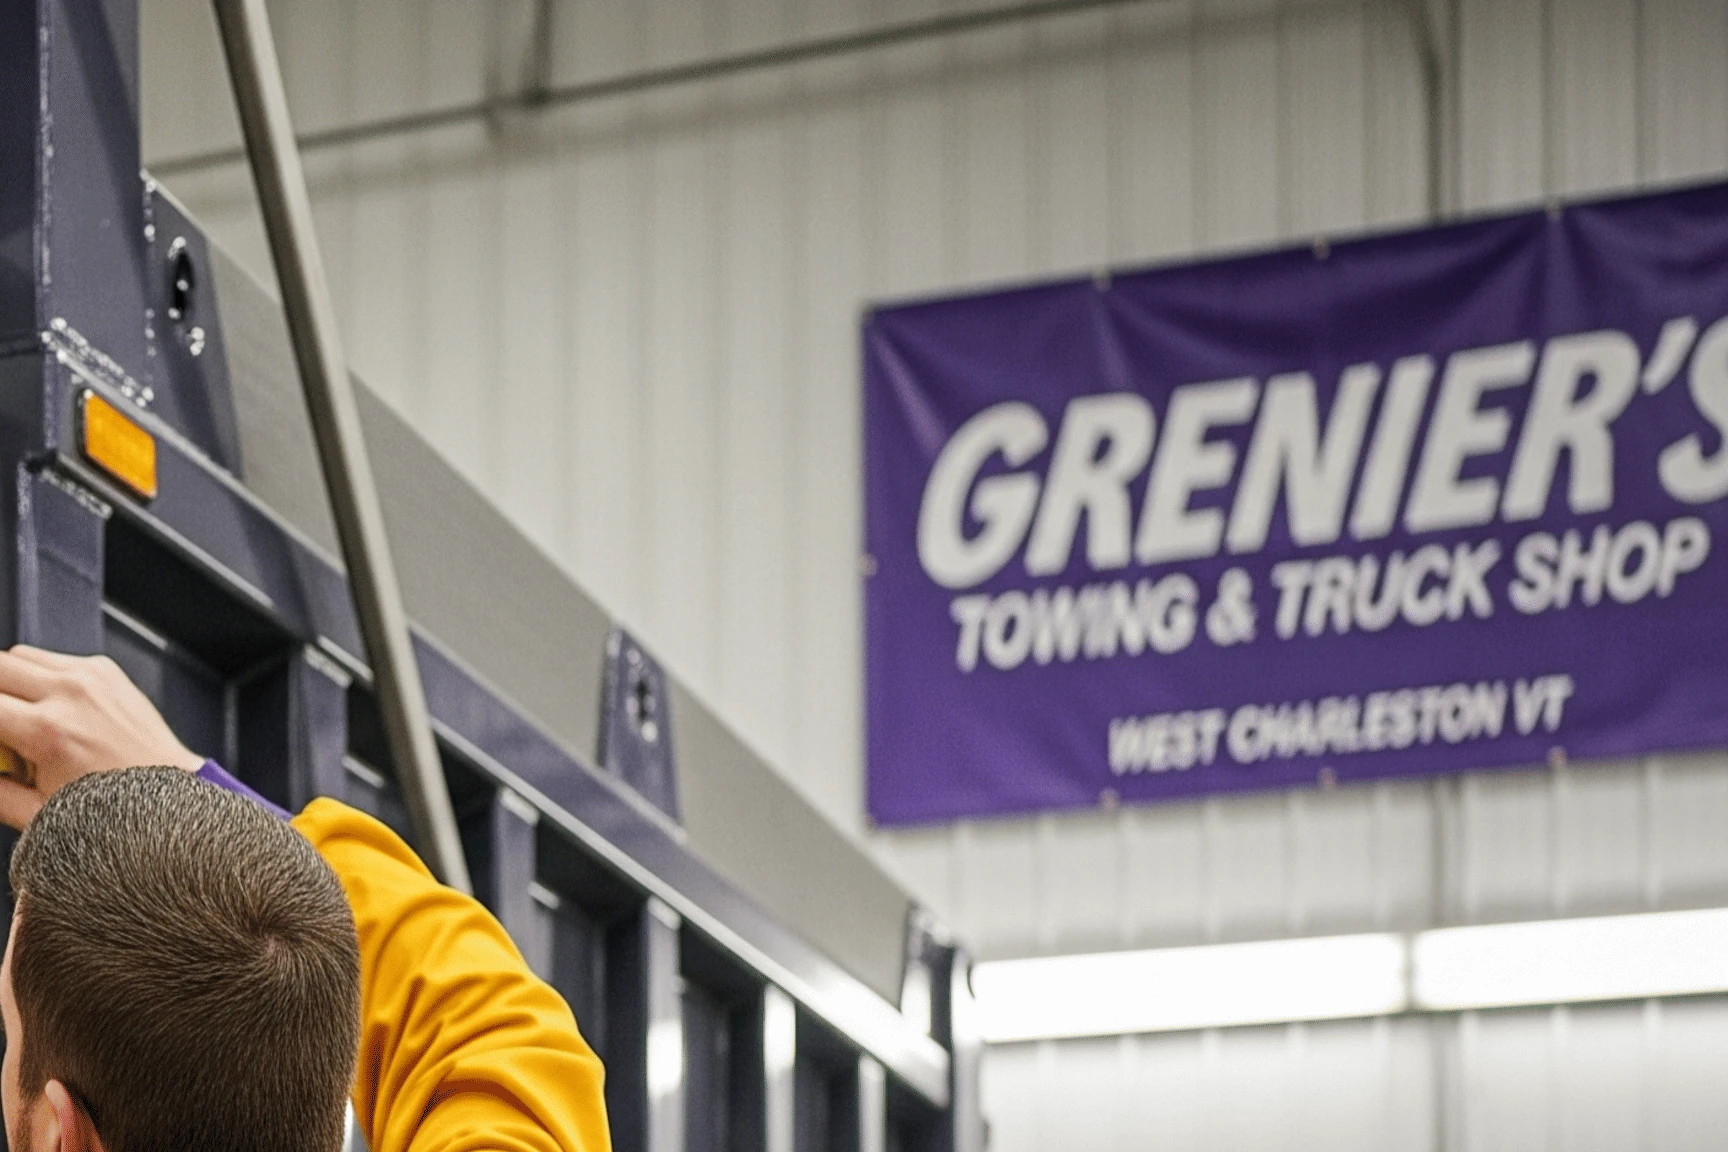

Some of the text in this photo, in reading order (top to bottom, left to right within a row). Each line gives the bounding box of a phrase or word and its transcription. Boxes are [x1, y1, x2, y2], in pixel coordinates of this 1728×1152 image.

[917, 316, 1728, 588] GRENIER'S
[948, 516, 1711, 671] TOWING & TRUCK SHOP
[1108, 674, 1575, 776] WEST CHARLESTON VT
